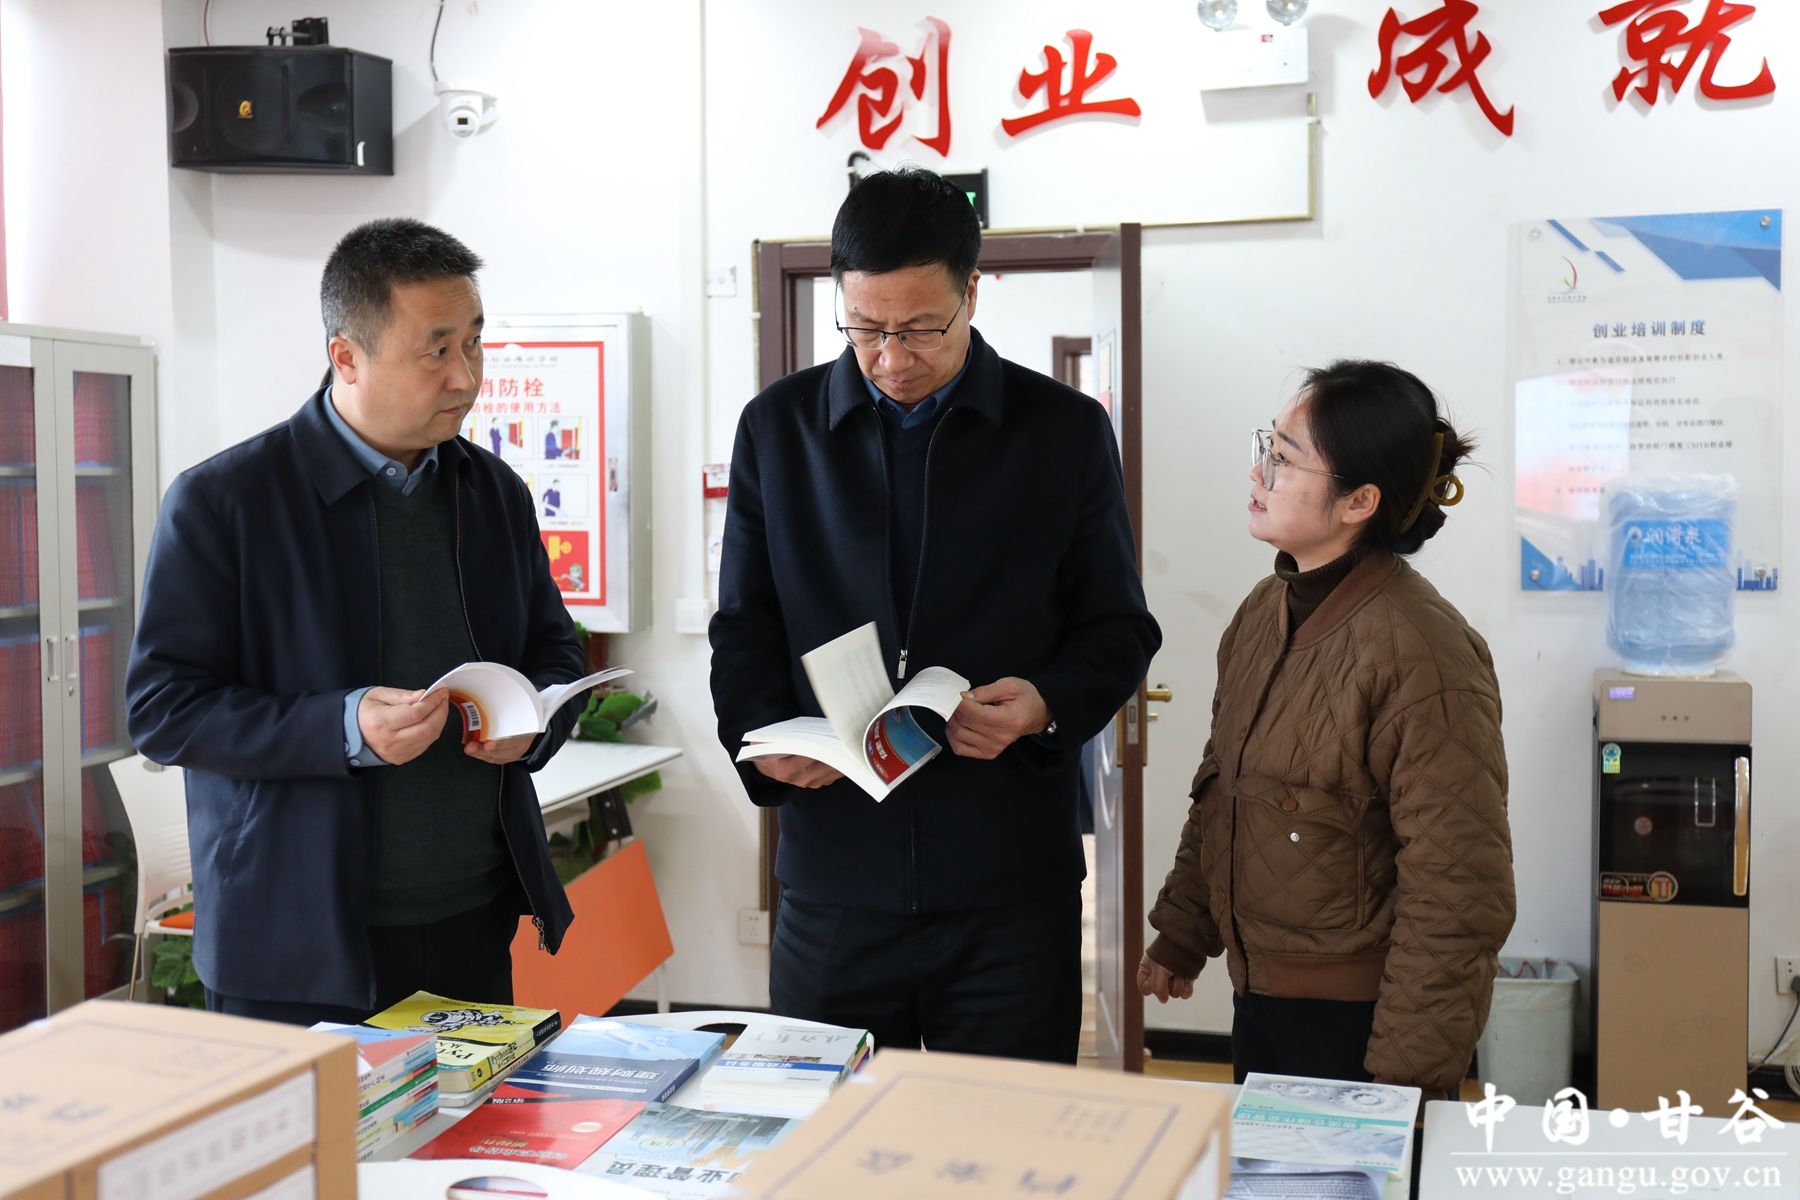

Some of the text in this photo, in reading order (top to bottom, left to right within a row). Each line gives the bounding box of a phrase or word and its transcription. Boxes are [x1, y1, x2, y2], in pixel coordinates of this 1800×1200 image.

[815, 0, 1777, 157] 创业 成就
[1593, 320, 1707, 339] 创业培训制度
[541, 1061, 662, 1081] 理财规划师
